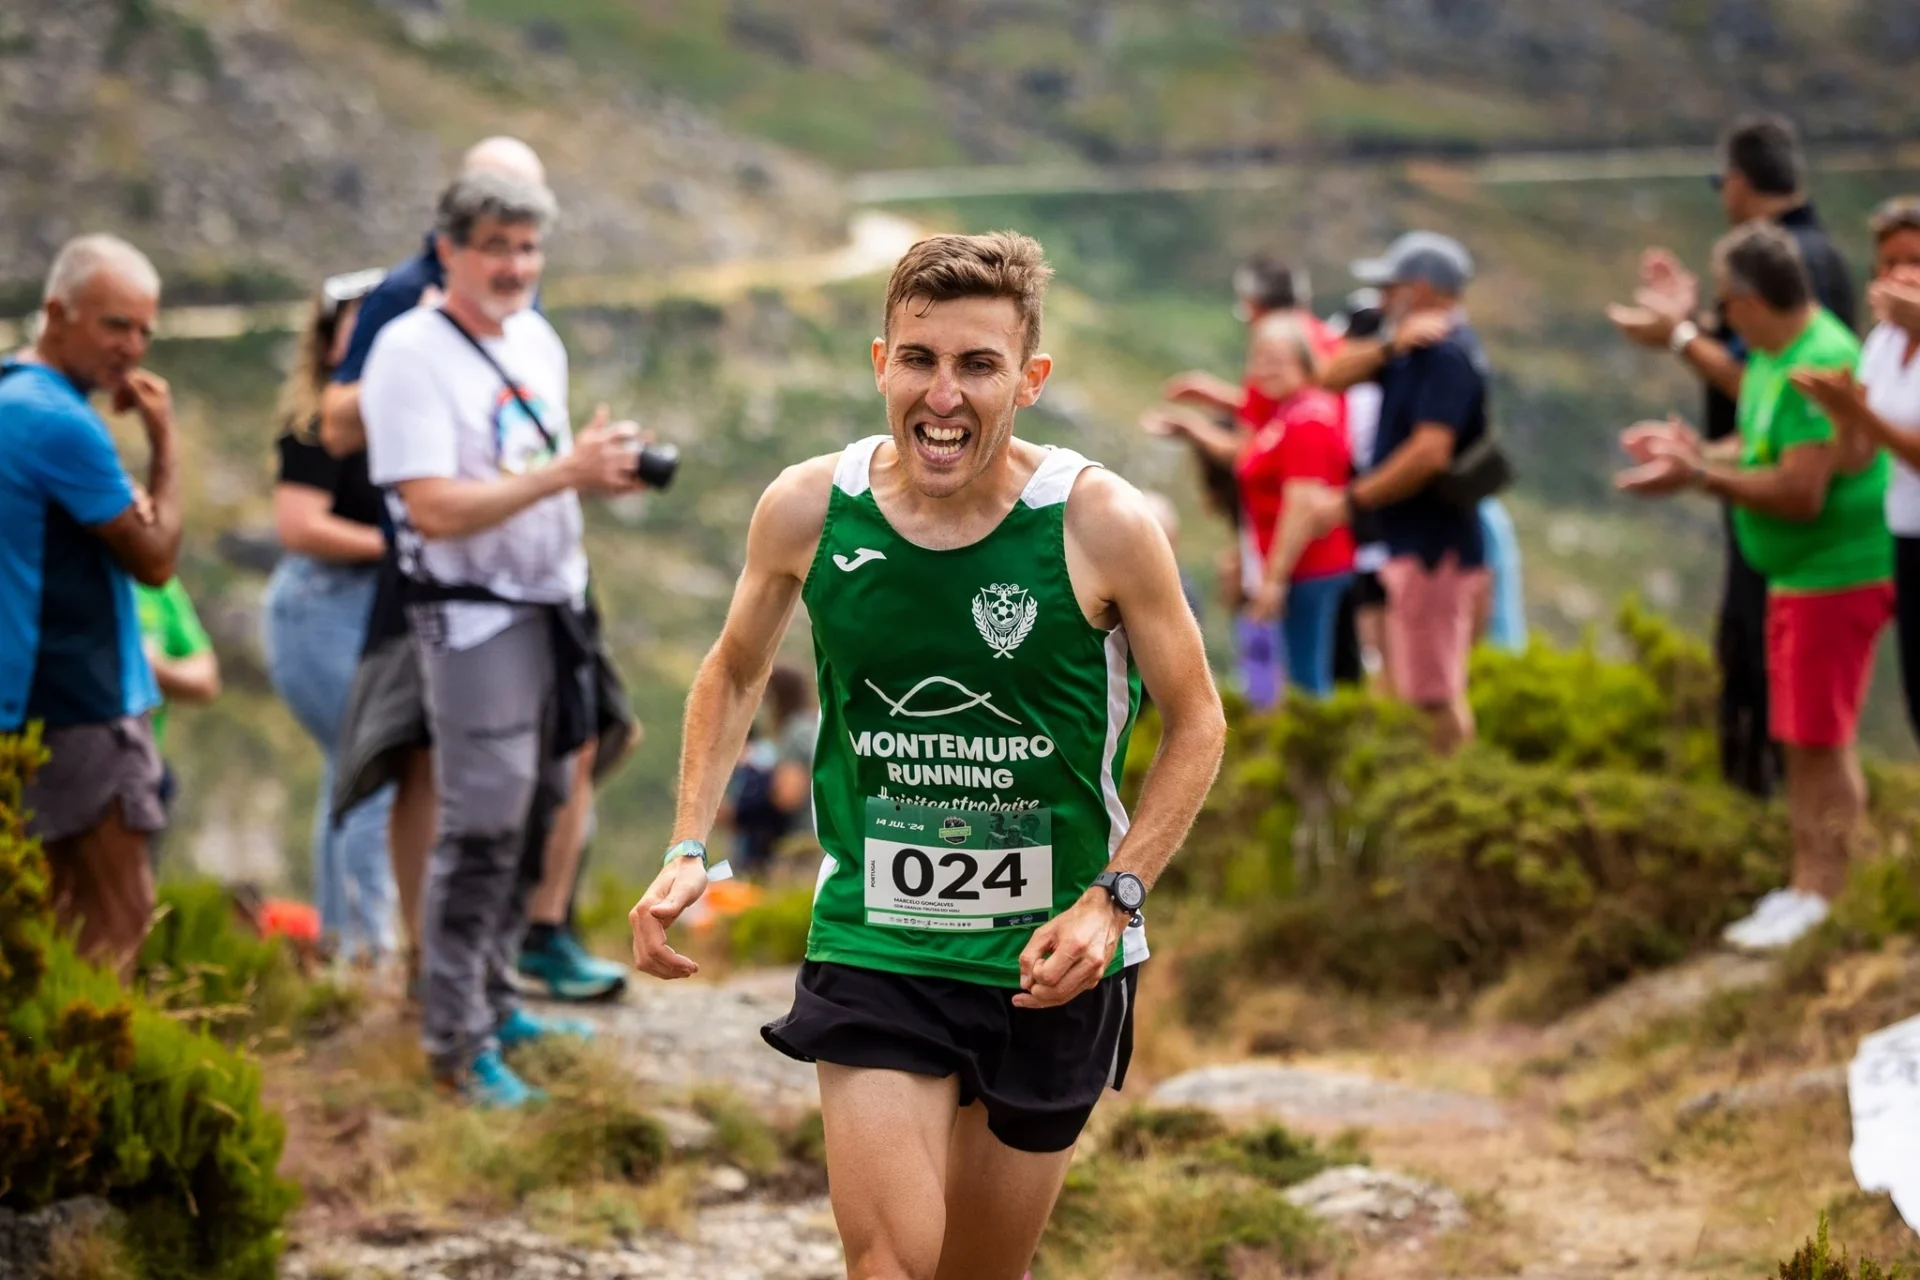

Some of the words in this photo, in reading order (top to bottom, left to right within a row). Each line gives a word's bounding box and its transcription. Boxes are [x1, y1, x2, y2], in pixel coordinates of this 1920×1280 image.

[848, 730, 1055, 762] MONTEMURO
[886, 762, 1014, 789] RUNNING
[875, 818, 887, 826] 14
[888, 820, 906, 829] JUL
[892, 848, 1028, 900] 024
